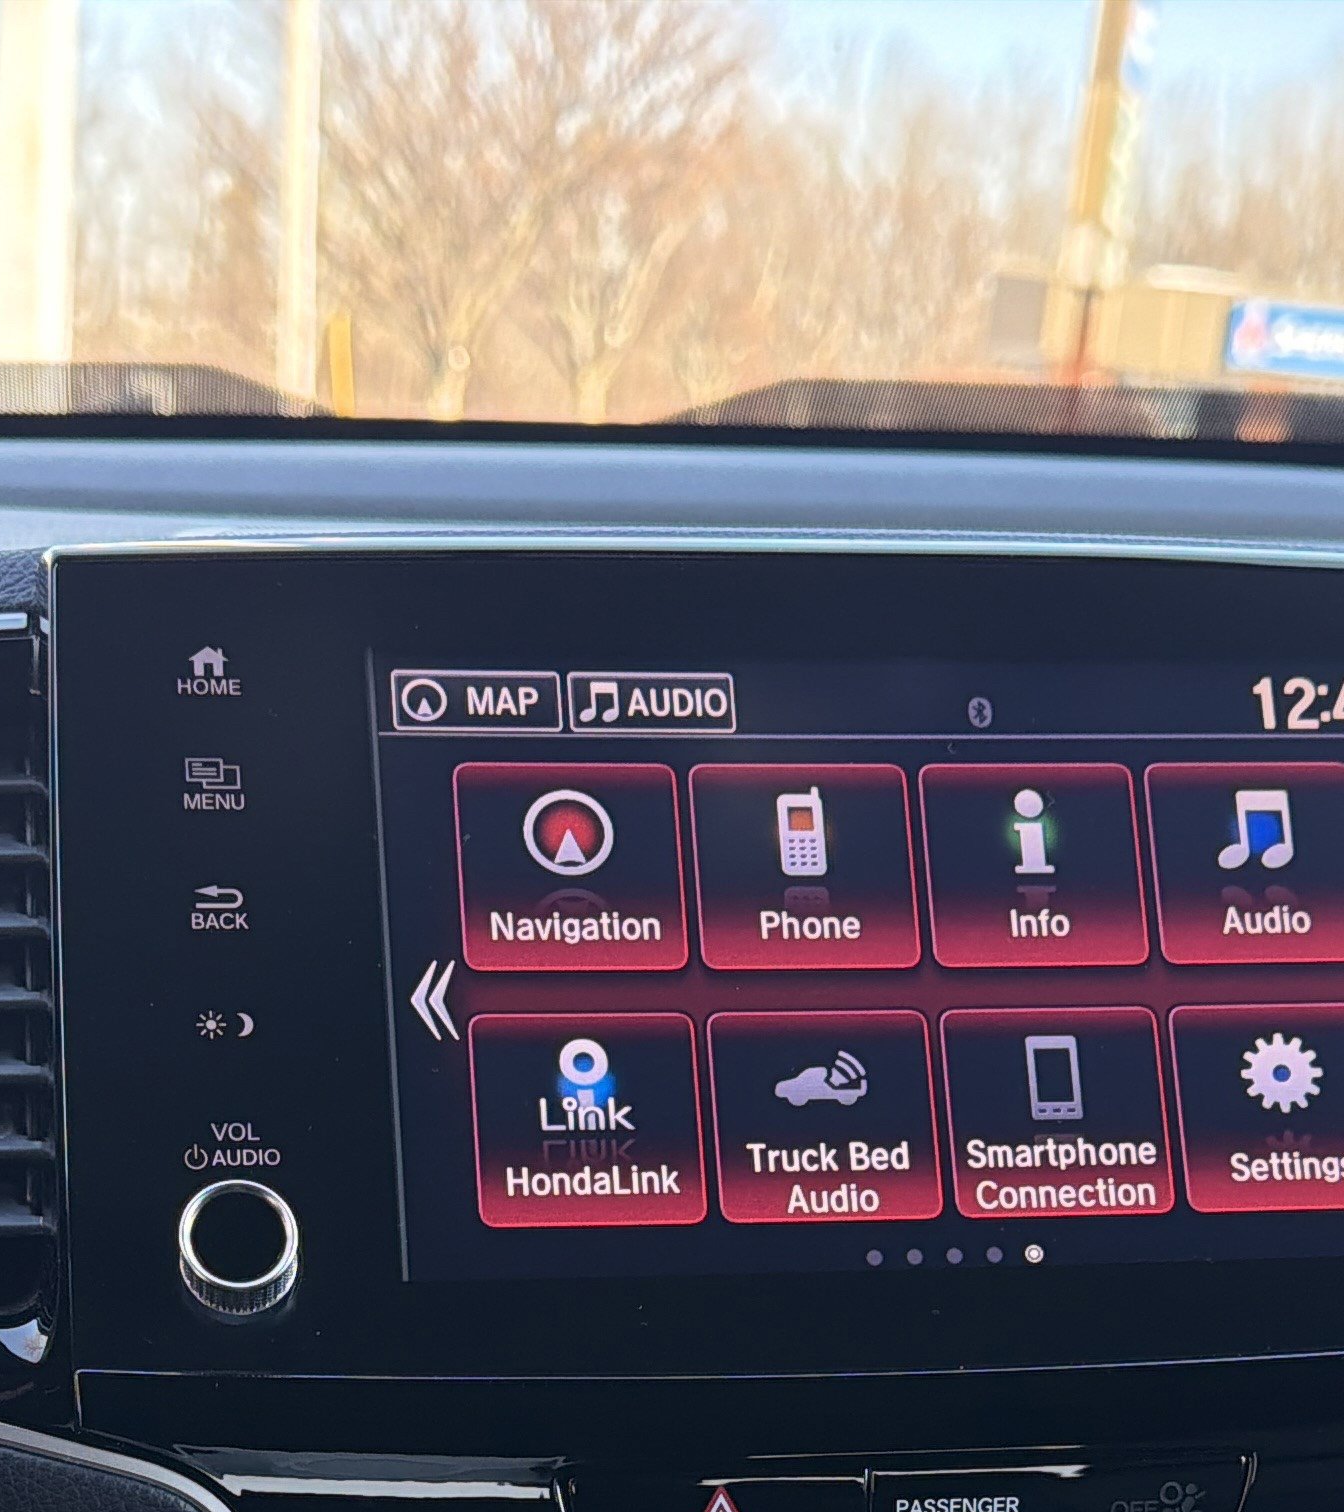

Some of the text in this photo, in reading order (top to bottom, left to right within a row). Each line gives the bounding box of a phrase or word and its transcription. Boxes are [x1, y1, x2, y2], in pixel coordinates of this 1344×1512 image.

[176, 678, 242, 697] HOME
[466, 687, 540, 717] MAP
[627, 688, 728, 718] AUDIO
[183, 792, 245, 811] MENU
[190, 911, 250, 930] BACK
[489, 911, 662, 945] Navigation
[760, 911, 861, 940] Phone
[1009, 909, 1071, 938] Info
[1222, 905, 1312, 935] Audio
[539, 1097, 635, 1132] Link
[210, 1122, 261, 1142] VOL
[212, 1147, 281, 1167] AUDIO
[746, 1140, 911, 1173] Truck Bed
[966, 1137, 1157, 1175] Smartphone
[505, 1165, 681, 1198] HondaLink
[975, 1178, 1157, 1210] Connection
[786, 1183, 880, 1215] Audio
